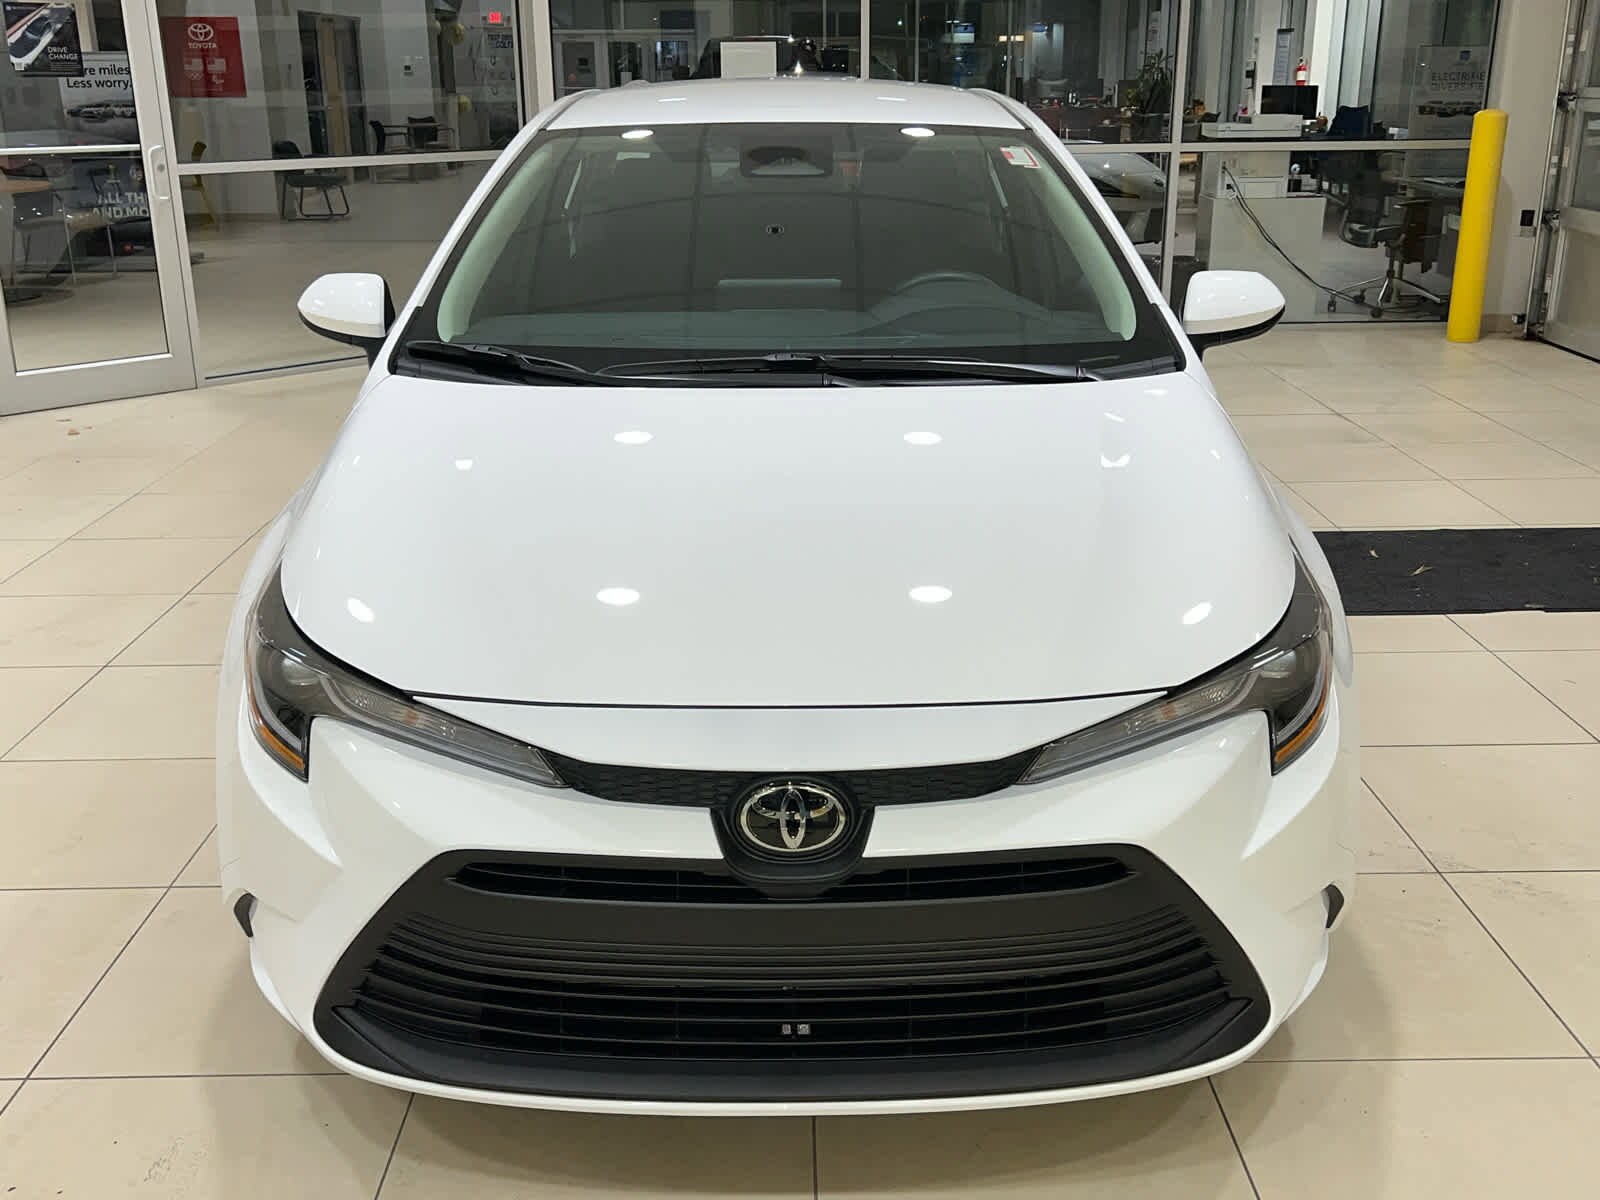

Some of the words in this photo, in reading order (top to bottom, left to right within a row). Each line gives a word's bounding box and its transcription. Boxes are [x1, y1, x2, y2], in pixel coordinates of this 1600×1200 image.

[84, 66, 95, 75] re
[99, 64, 130, 75] miles
[1431, 71, 1486, 81] ELECTRIFIE
[67, 78, 92, 88] Less
[98, 192, 123, 204] ALL
[92, 206, 123, 218] AND
[126, 206, 149, 217] MO
